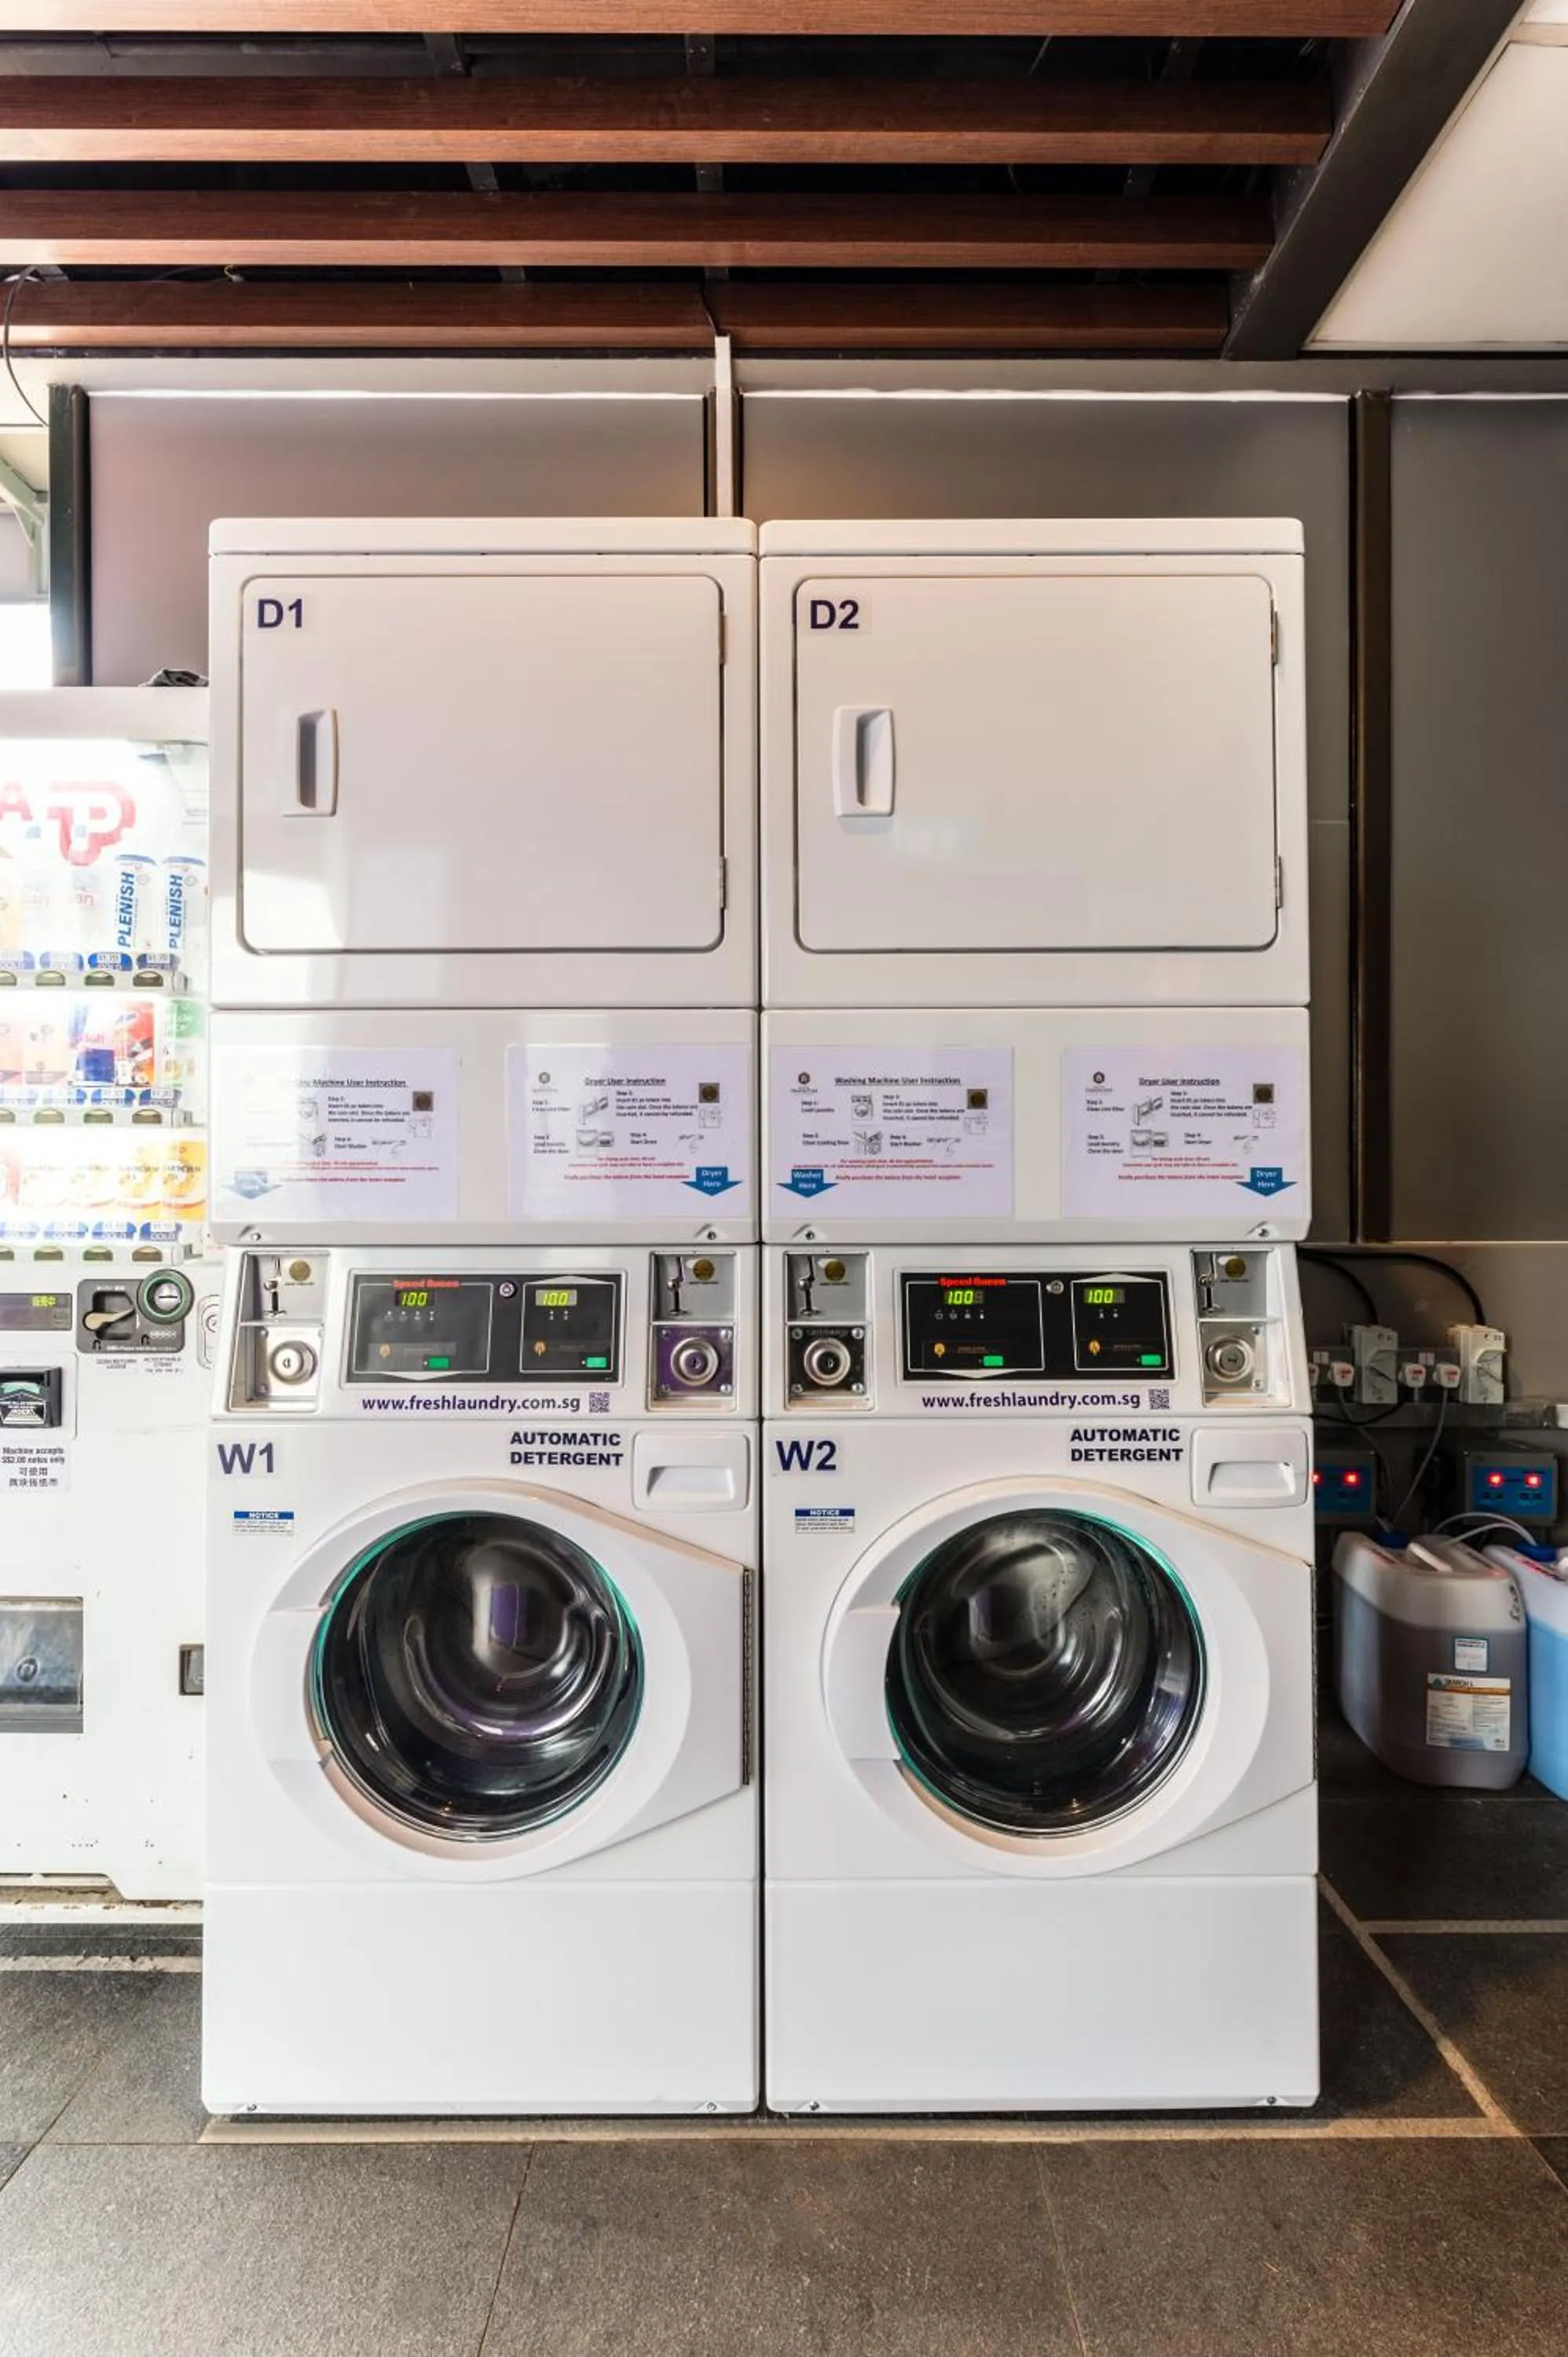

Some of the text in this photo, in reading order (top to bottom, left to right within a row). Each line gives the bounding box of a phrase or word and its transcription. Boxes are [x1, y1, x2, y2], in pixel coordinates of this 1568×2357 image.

[258, 598, 302, 629] D1
[810, 599, 859, 629] D2
[118, 871, 135, 948] PLENISH
[169, 874, 184, 949] PLENISH
[793, 1171, 822, 1179] Washer
[1257, 1170, 1277, 1178] Dryer
[940, 1277, 972, 1287] Speed
[401, 1292, 428, 1307] 100
[542, 1293, 569, 1307] 100
[947, 1290, 973, 1305] 100
[1087, 1289, 1114, 1303] 100
[362, 1395, 581, 1413] www.freshlaundry.com.sg
[922, 1391, 1141, 1409] www.freshlaundry.com.sg
[511, 1431, 621, 1446] AUTOMATIC
[1070, 1428, 1181, 1442] AUTOMATIC
[49, 1456, 65, 1465] only
[217, 1442, 275, 1475] W1
[511, 1451, 624, 1466] DETERGENT
[775, 1439, 837, 1472] W2
[1071, 1448, 1184, 1462] DETERGENT
